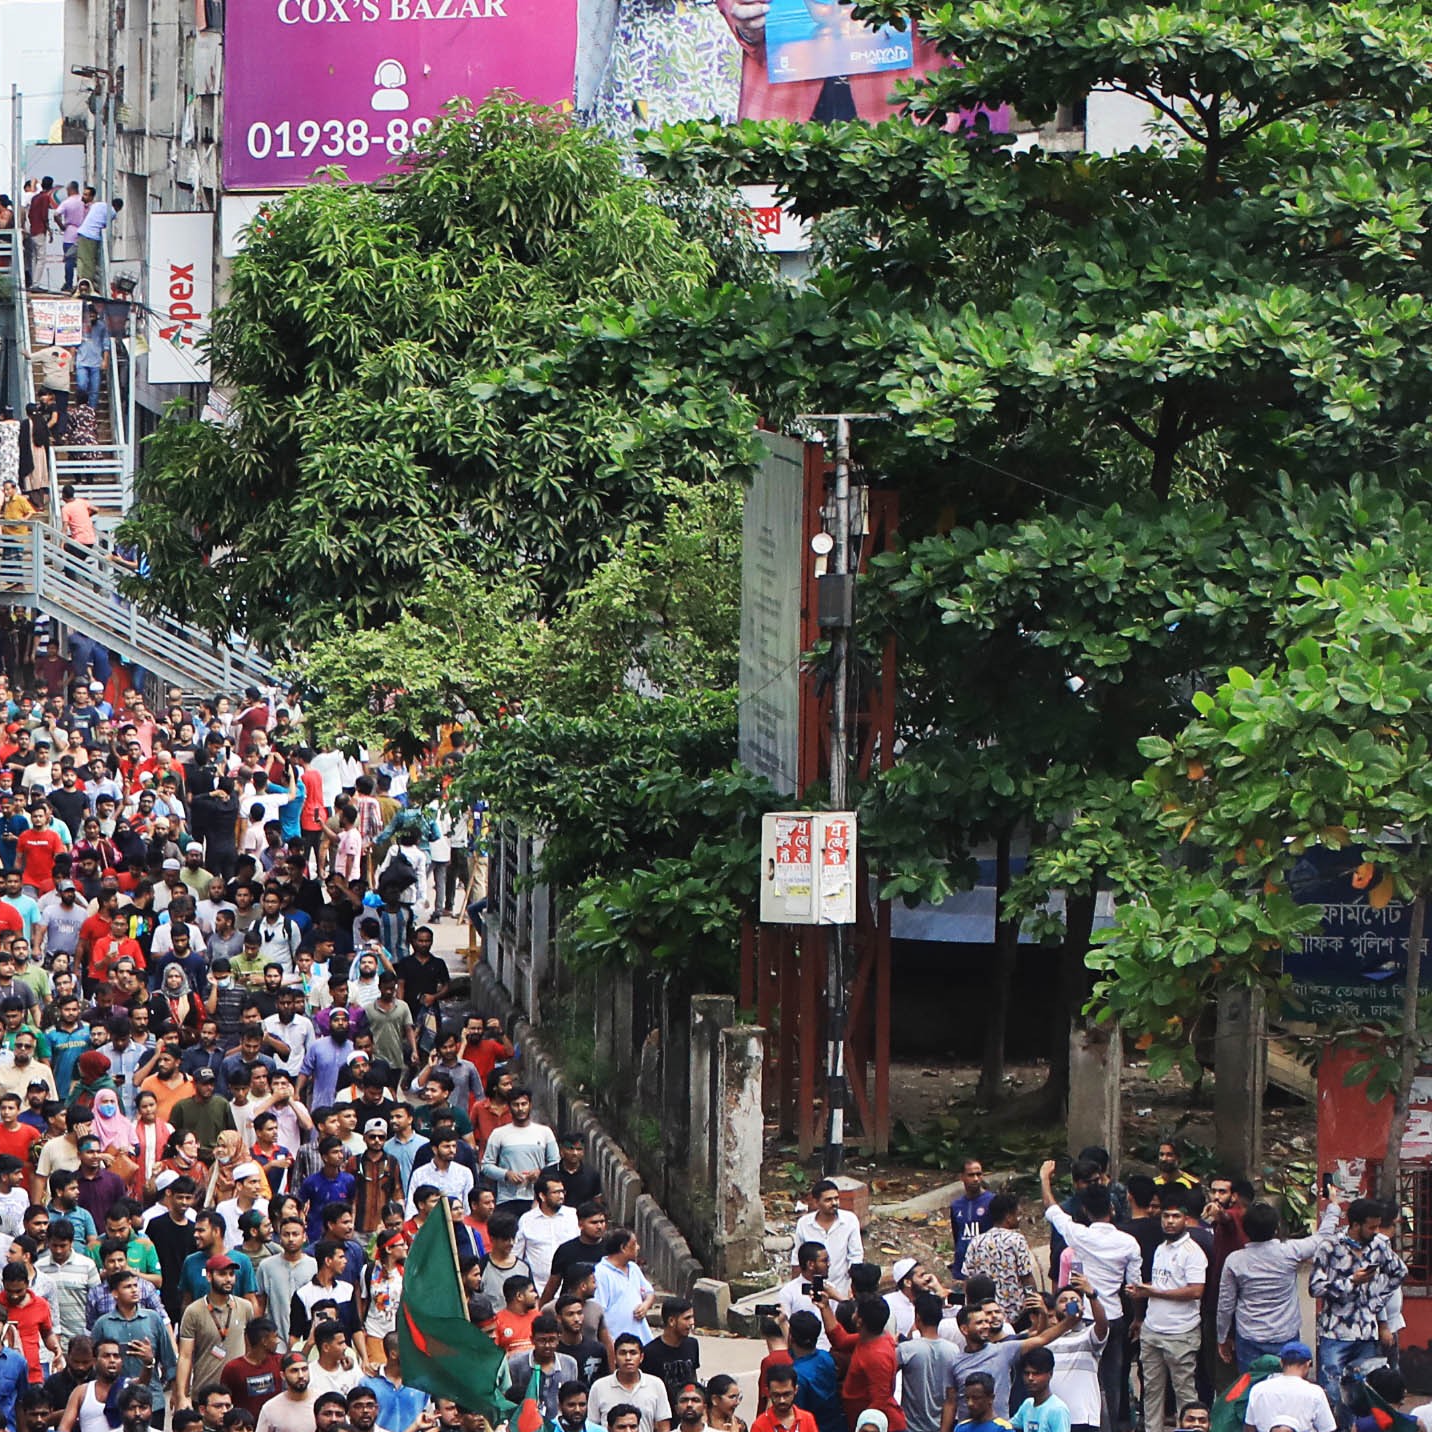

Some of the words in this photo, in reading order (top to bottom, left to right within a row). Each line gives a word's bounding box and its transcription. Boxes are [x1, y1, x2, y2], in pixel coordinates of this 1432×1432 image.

[389, 0, 507, 20] BAZAR
[159, 264, 201, 346] Apex
[1323, 896, 1404, 925] ফার্মগেট
